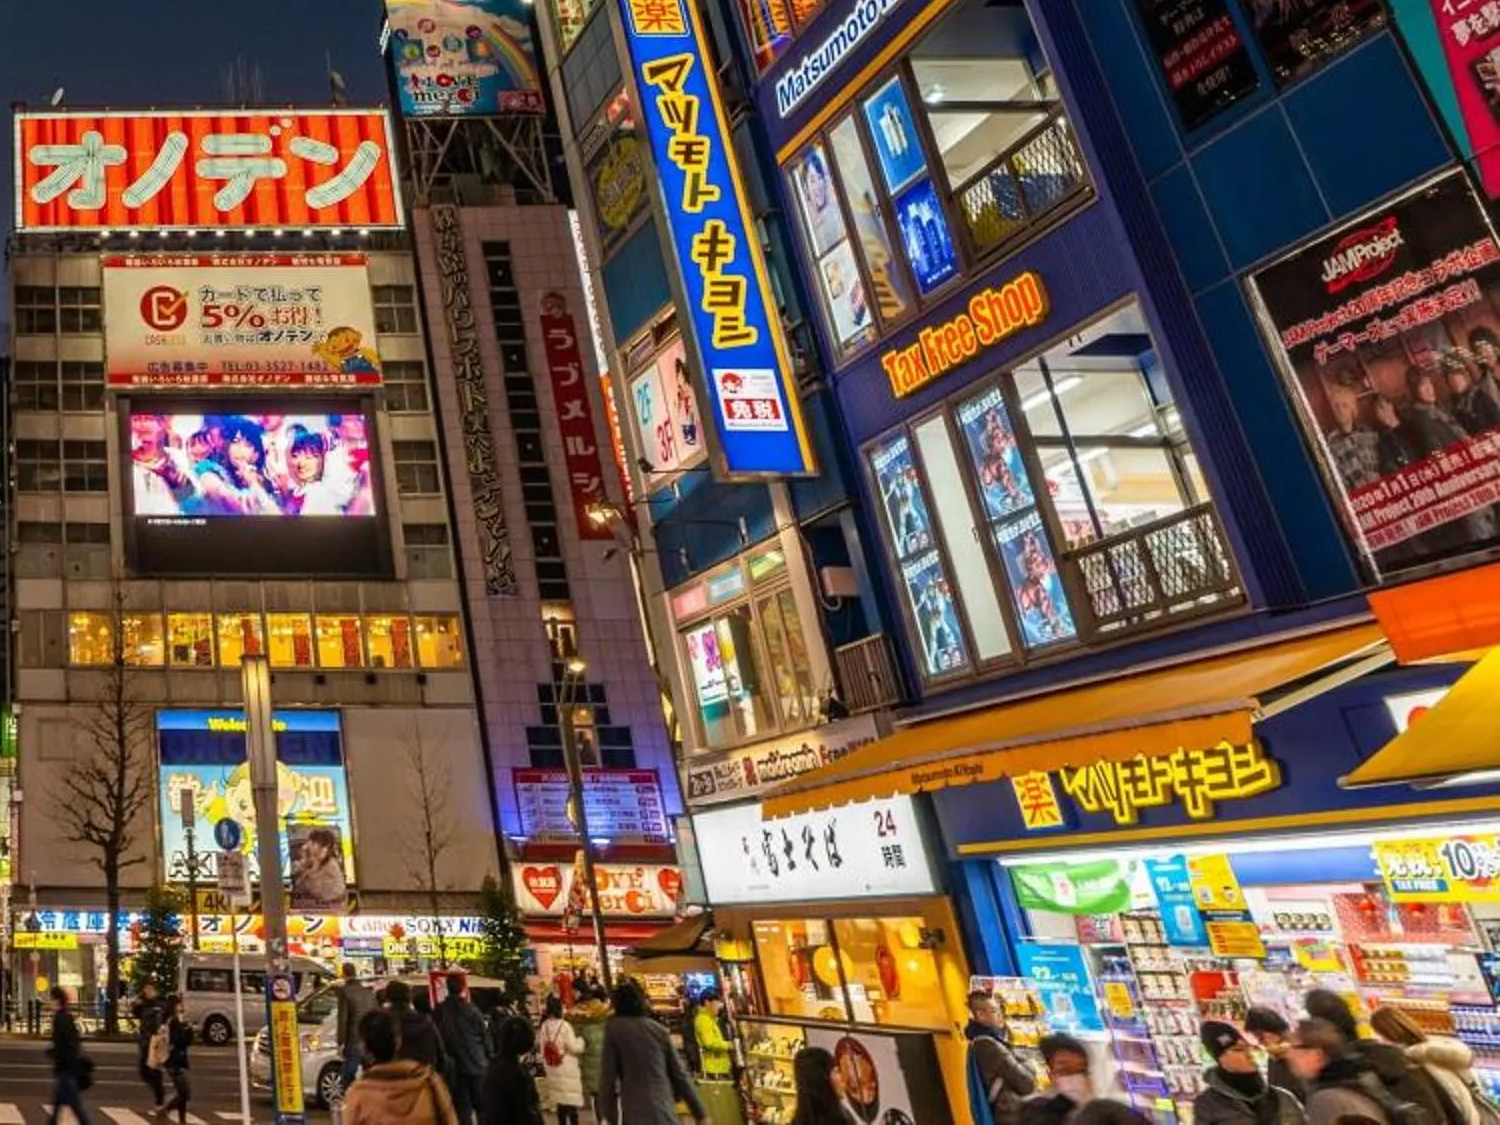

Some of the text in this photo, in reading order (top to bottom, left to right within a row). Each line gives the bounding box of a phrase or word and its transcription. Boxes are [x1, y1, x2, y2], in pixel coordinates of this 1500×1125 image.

[30, 118, 382, 212] オノデン
[200, 285, 321, 303] カードで払って
[883, 271, 1043, 397] Tax Free Shop
[727, 400, 781, 421] 免税
[874, 810, 896, 836] 24
[200, 915, 324, 934] オノン
